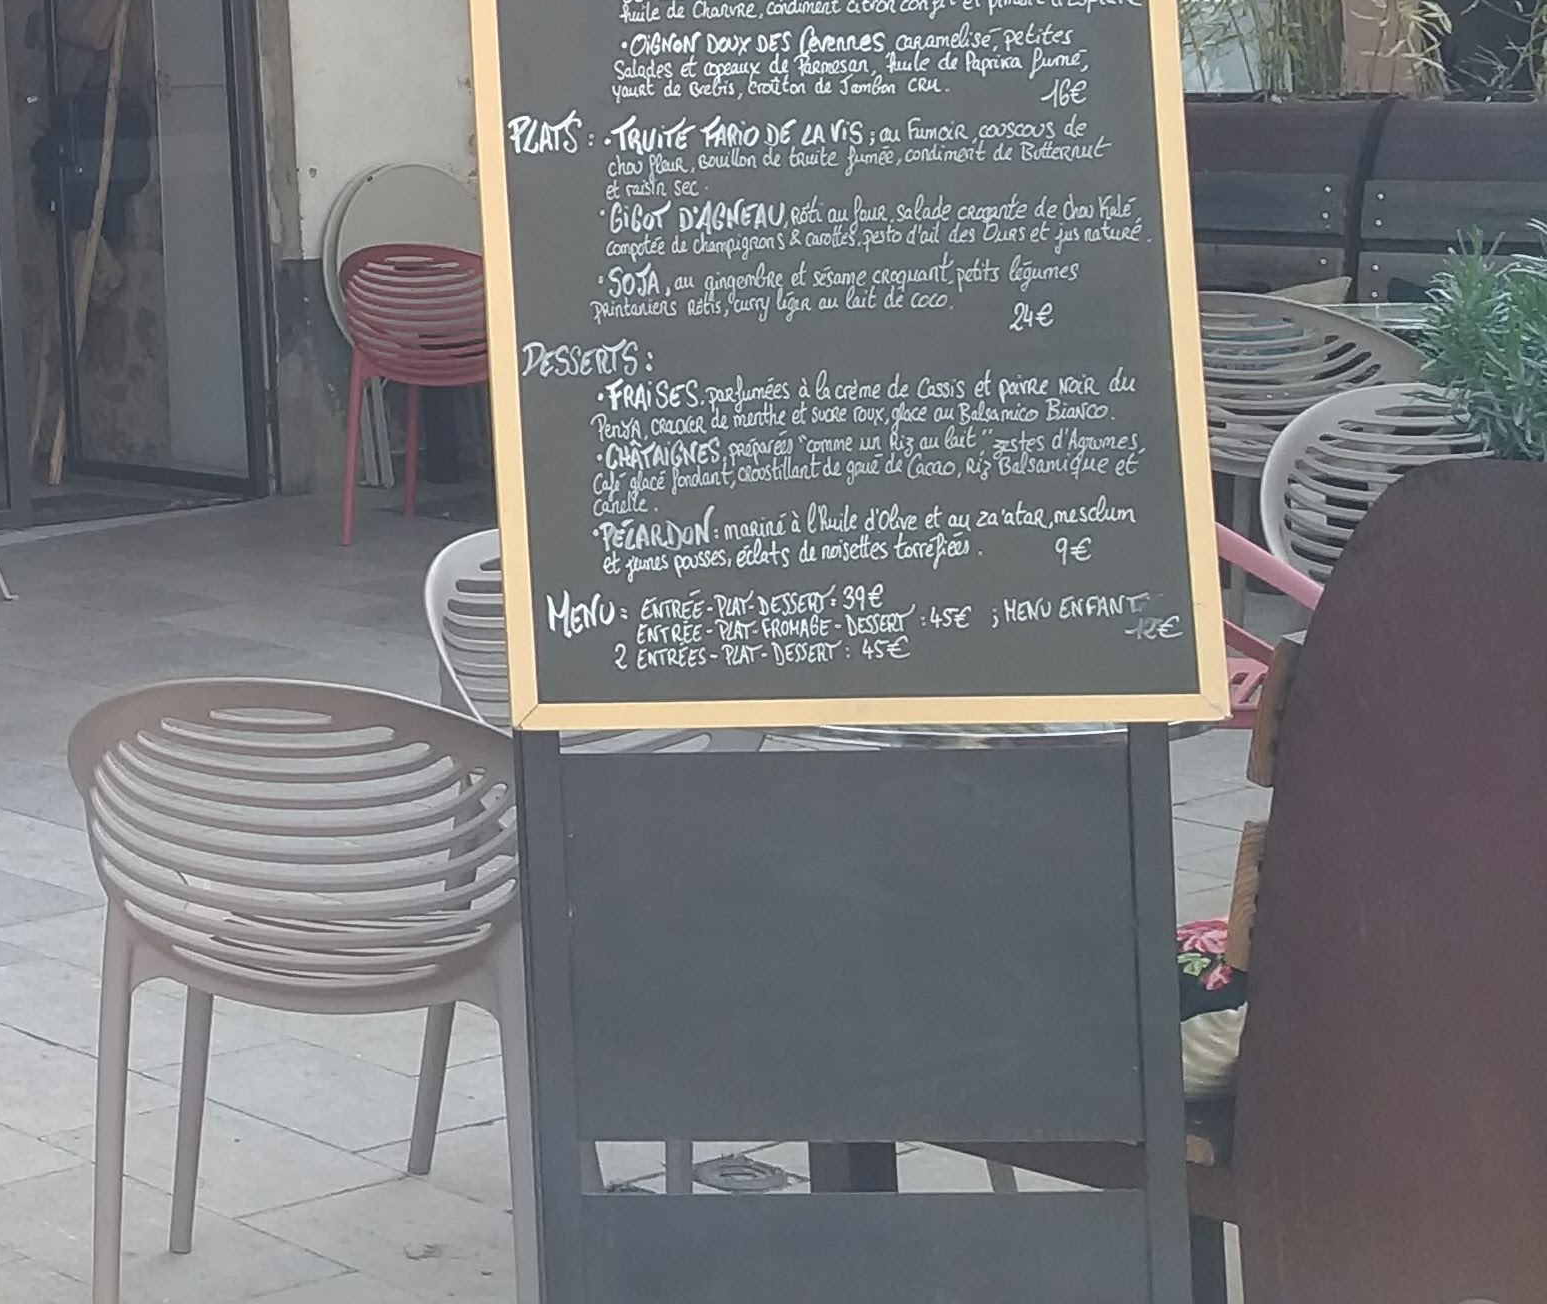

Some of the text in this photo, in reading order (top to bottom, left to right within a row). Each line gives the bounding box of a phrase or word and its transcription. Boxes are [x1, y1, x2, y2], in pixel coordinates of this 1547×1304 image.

[620, 0, 661, 23] huile
[707, 23, 1073, 57] DOUX DES petites
[681, 51, 959, 77] et de de
[664, 78, 682, 97] de
[814, 77, 833, 95] de
[764, 118, 797, 147] DE
[800, 123, 826, 145] LA
[1065, 113, 1087, 138] de
[763, 147, 782, 168] de
[905, 139, 987, 163] condiment
[993, 141, 1013, 161] de
[606, 178, 700, 201] et raisin sec
[896, 194, 952, 222] salade
[1034, 195, 1057, 219] de
[671, 234, 689, 255] de
[865, 224, 902, 253] pesto
[907, 223, 941, 246] d'ail
[949, 225, 976, 245] des
[1030, 223, 1050, 242] et
[1055, 227, 1080, 255] jus
[812, 265, 866, 289] sésame
[956, 258, 1000, 293] petits
[846, 286, 1055, 332] lait 24€
[887, 373, 909, 397] de
[973, 369, 992, 398] et
[711, 402, 807, 430] de menthe et
[1115, 452, 1140, 478] et
[925, 504, 943, 529] et
[602, 534, 889, 575] et éclats de noisettes
[1004, 596, 1053, 622] MENU
